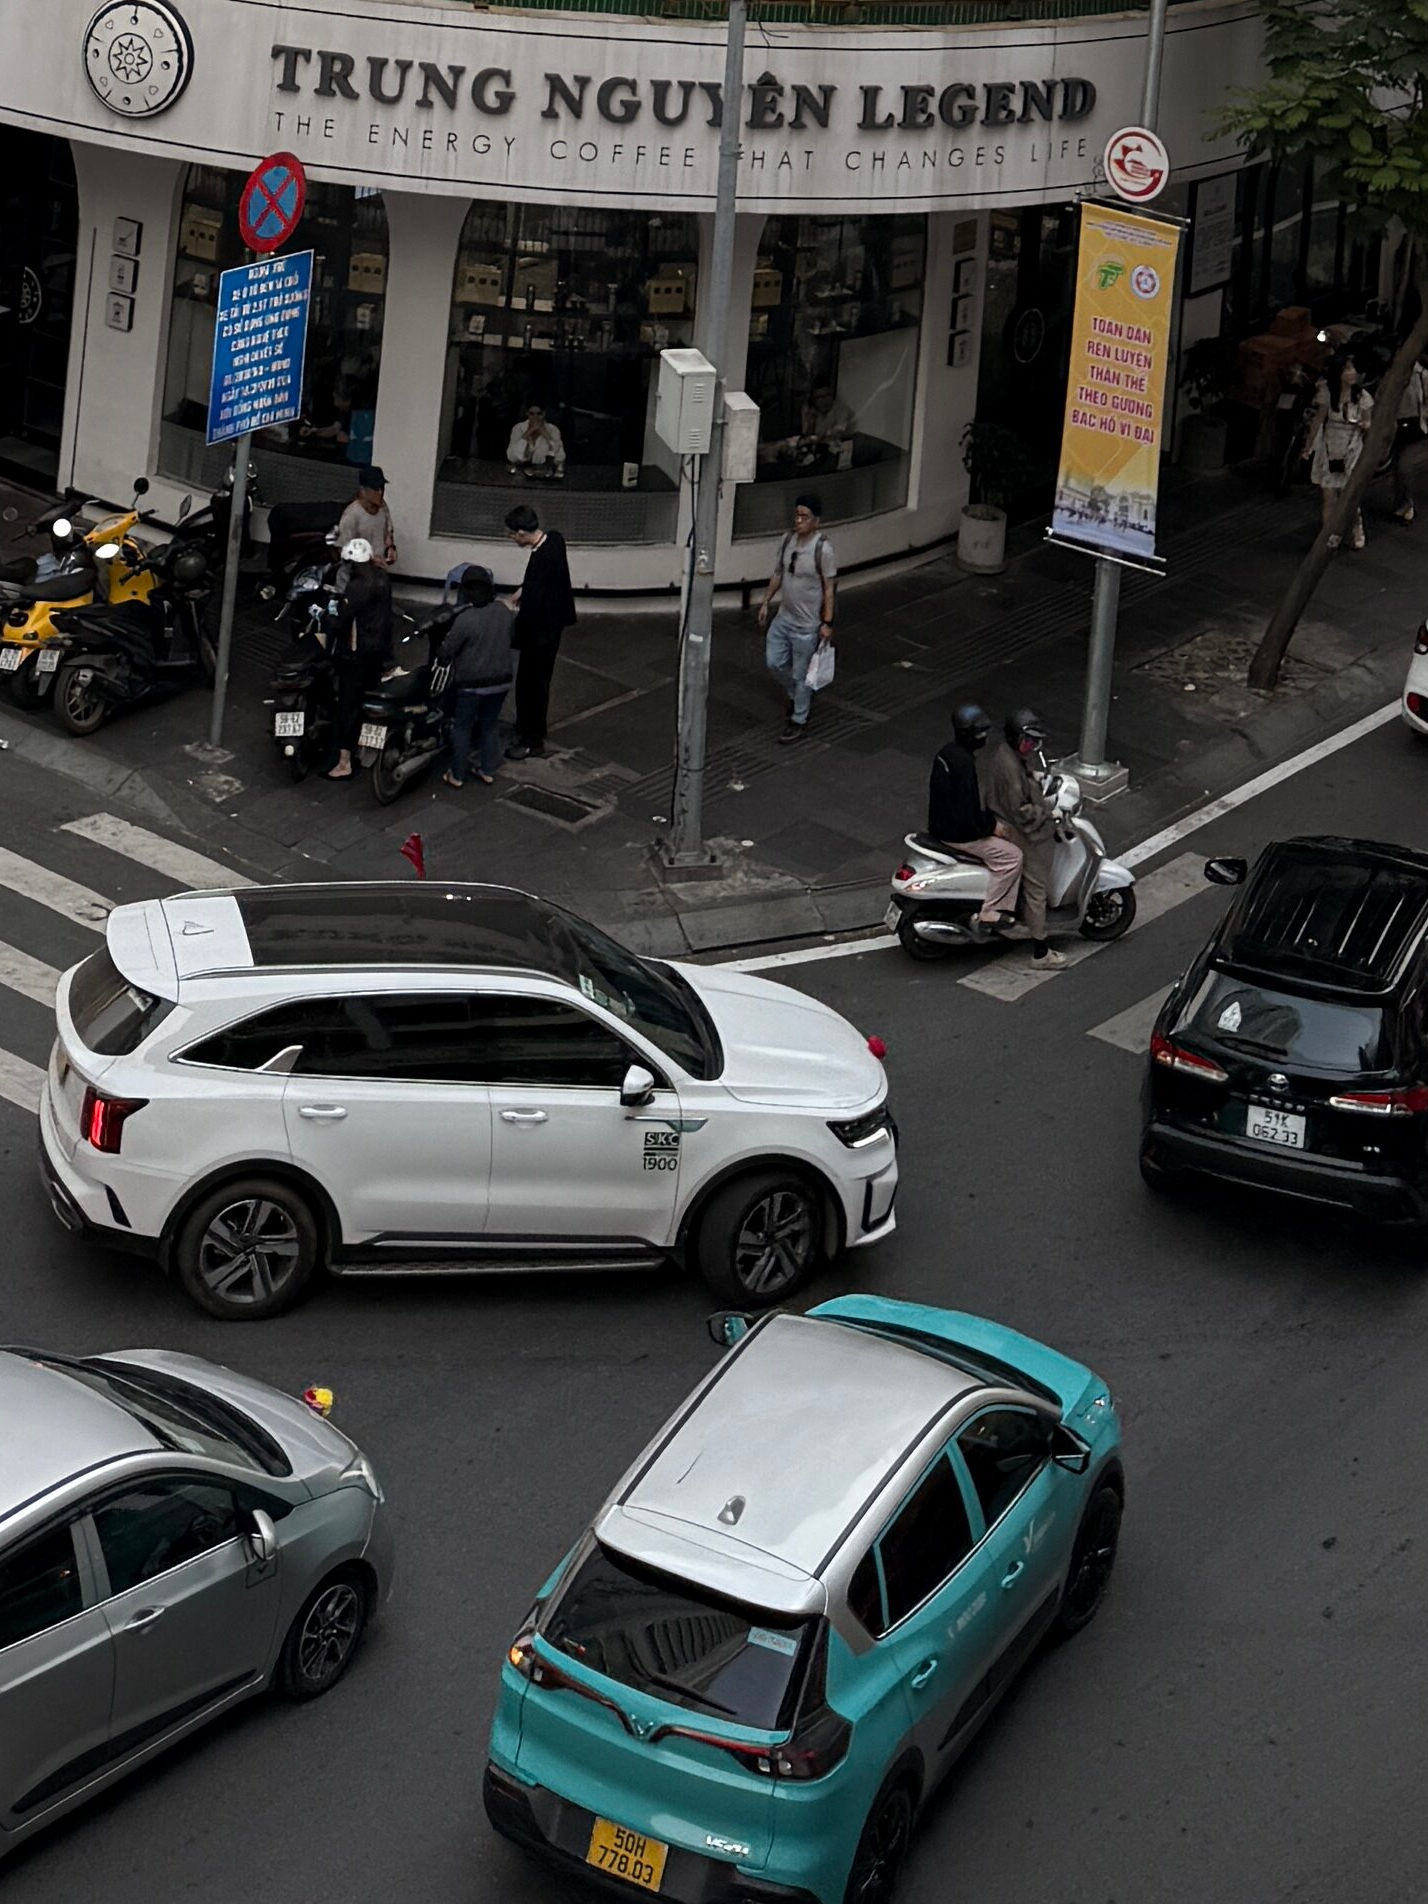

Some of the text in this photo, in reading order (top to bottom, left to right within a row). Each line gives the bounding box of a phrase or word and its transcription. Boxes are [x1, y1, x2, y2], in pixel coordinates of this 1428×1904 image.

[271, 44, 517, 117] TRUNG
[857, 77, 1098, 130] LEGEND
[275, 111, 1087, 171] THE ENERGY COFFEE HAT CHANGES LIFE
[1264, 1110, 1290, 1128] 51K
[645, 1132, 680, 1146] SKC
[643, 1157, 678, 1171] 1900
[615, 1827, 647, 1859] 50H
[597, 1845, 654, 1884] 778.03
